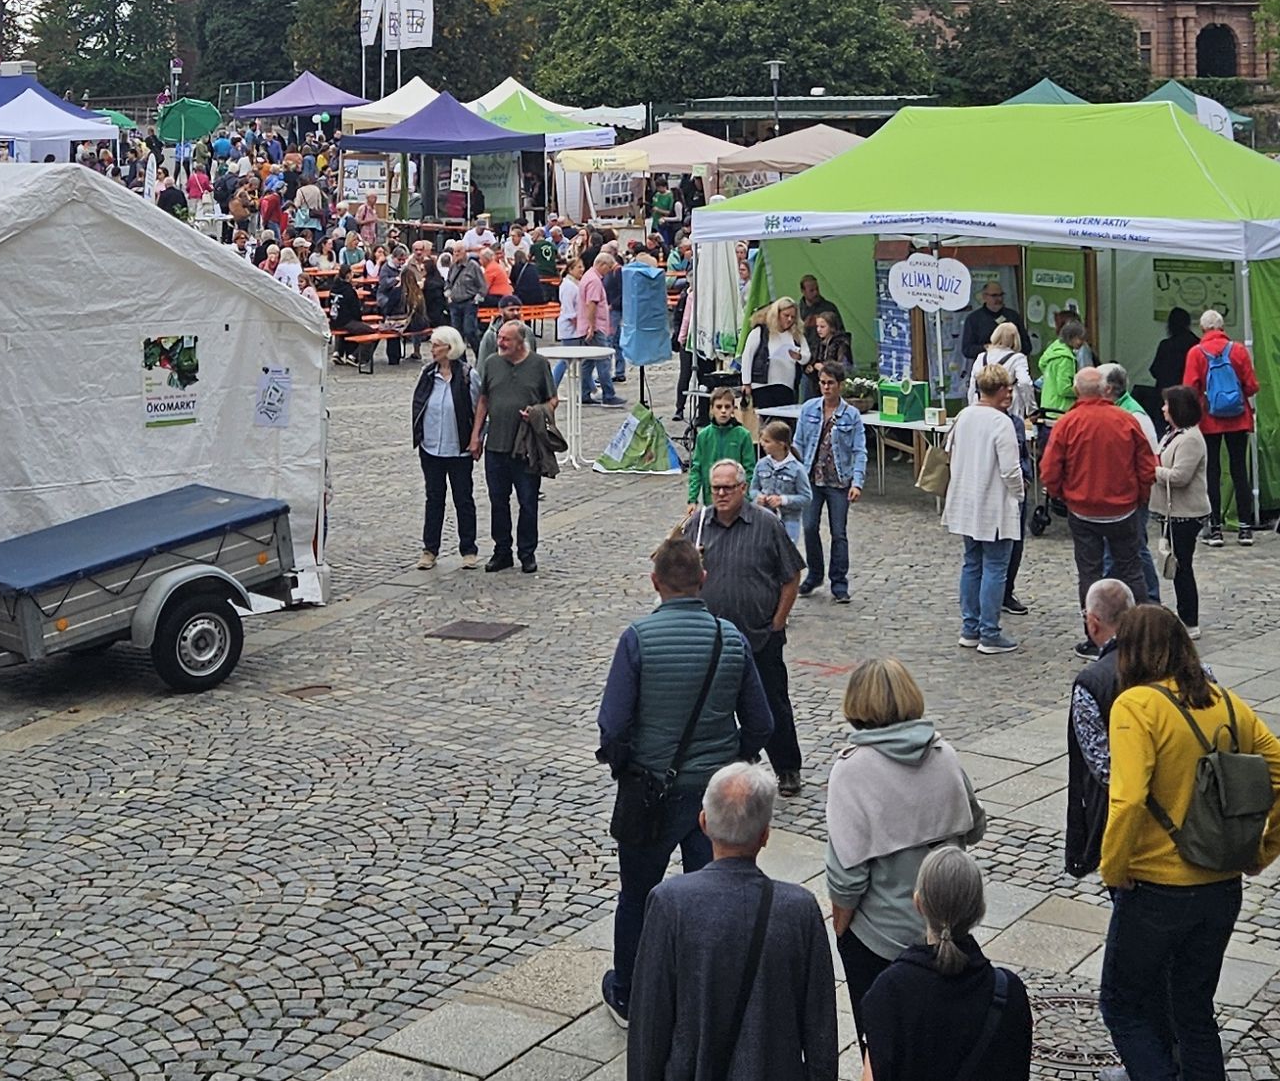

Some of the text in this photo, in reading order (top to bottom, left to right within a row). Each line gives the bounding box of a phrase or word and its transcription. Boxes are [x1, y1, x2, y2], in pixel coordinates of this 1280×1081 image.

[783, 215, 802, 223] BUND
[1102, 218, 1131, 228] AKTIV
[1081, 229, 1111, 239] Mensch
[1128, 234, 1151, 243] Natur
[146, 400, 197, 413] ÖKOMARKT
